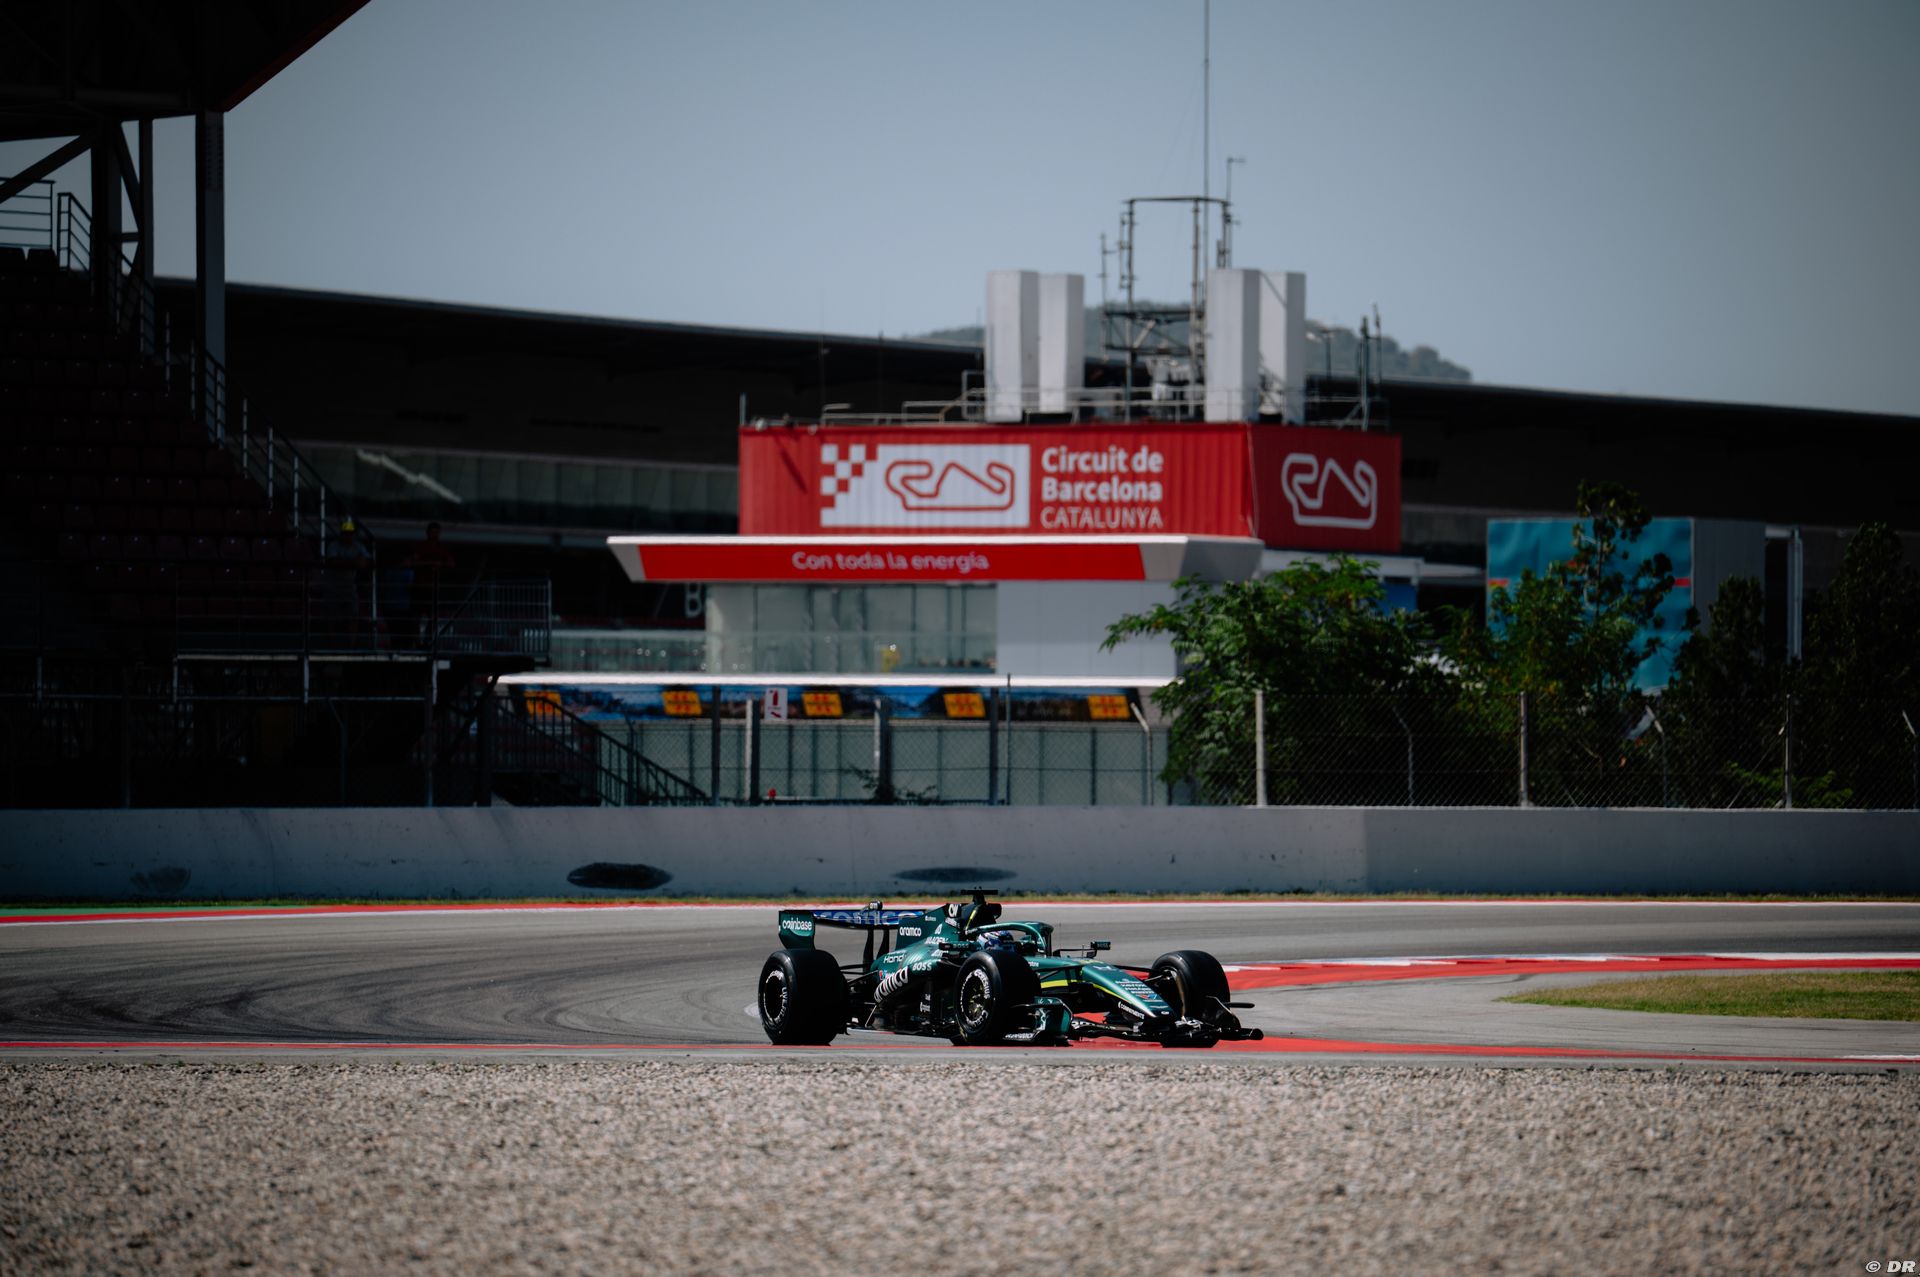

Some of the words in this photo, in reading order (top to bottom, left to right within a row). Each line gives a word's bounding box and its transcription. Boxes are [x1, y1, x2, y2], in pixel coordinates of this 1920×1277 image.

[1042, 445, 1128, 473] Circuit
[1131, 445, 1164, 473] de
[1042, 475, 1163, 502] Barcelona
[1040, 506, 1164, 529] CATALUNYA
[792, 551, 833, 570] Con
[835, 552, 885, 570] toda
[887, 551, 909, 570] la
[911, 552, 990, 574] energía
[782, 917, 812, 931] coinbase
[899, 926, 922, 937] aramco
[883, 953, 907, 964] Hond
[912, 960, 932, 971] BOSS
[873, 966, 909, 1003] aramco
